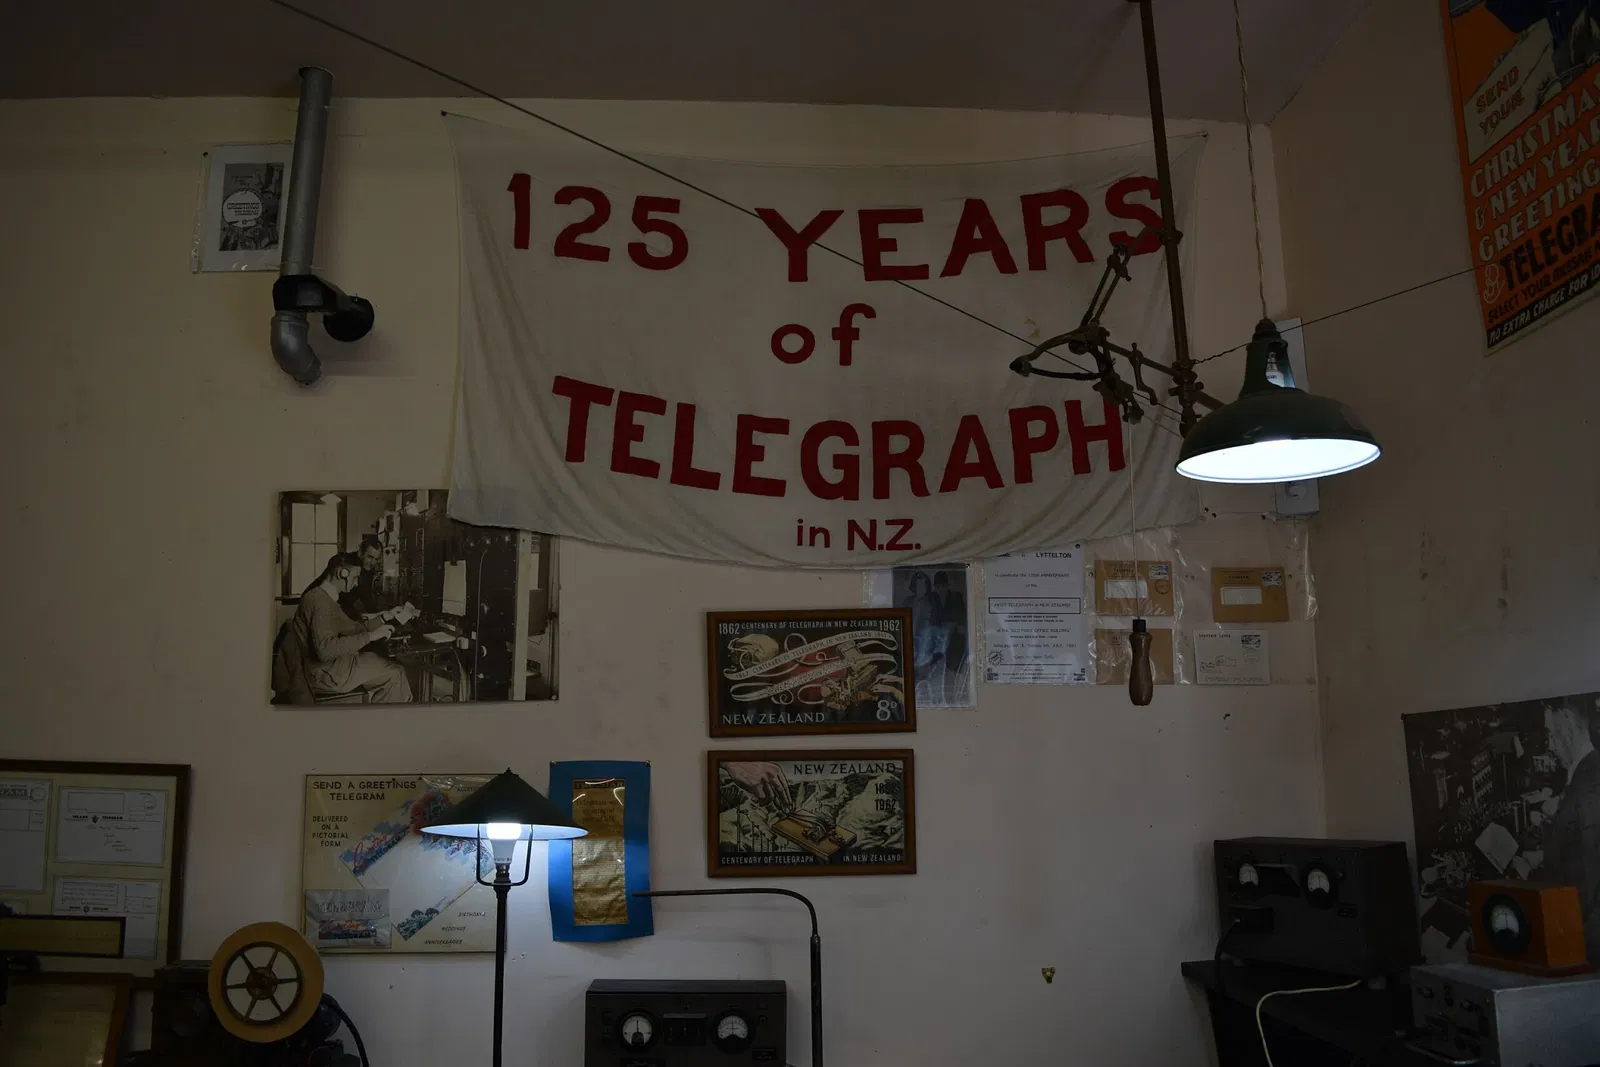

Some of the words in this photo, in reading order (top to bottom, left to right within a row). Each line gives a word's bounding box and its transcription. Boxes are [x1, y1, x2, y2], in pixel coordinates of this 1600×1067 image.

[1476, 66, 1519, 114] SEND
[1479, 91, 1525, 136] YOUR
[1489, 164, 1537, 220] NEW
[507, 173, 689, 271] 125
[754, 176, 1164, 282] YEARS
[1487, 293, 1520, 323] SELECT
[1521, 273, 1551, 300] YOUR
[1488, 327, 1500, 344] NO
[1502, 309, 1531, 336] EXTRA
[1533, 287, 1567, 317] CHARGE
[1567, 273, 1589, 296] FOR
[771, 303, 876, 366] of
[552, 375, 1126, 501] TELEGRAPH
[797, 519, 830, 548] in
[847, 519, 921, 550] N.Z.
[719, 623, 740, 635] 1862
[741, 621, 777, 631] CENTENARY
[779, 621, 787, 629] OF
[789, 620, 824, 630] TELEGRAPH
[826, 620, 832, 628] IN
[834, 620, 849, 628] NEW
[850, 619, 878, 628] ZEALAND
[879, 619, 900, 631] 1962
[752, 658, 782, 676] CENTENARY
[793, 640, 826, 660] TELEGRAPH
[848, 631, 872, 641] ZEALAND
[722, 713, 754, 725] NEW
[759, 711, 825, 725] ZEALAND
[312, 781, 342, 790] SEND
[348, 780, 355, 789] A
[359, 780, 417, 789] GREETINGS
[794, 763, 825, 775] NEW
[830, 762, 896, 775] ZEALAND
[329, 792, 385, 801] TELEGRAM
[875, 798, 896, 811] 1962
[312, 815, 348, 823] DELIVERED
[721, 856, 761, 865] CENTENARY
[764, 856, 772, 864] OF
[774, 855, 814, 864] TELEGRAPH
[843, 855, 850, 863] IN
[852, 854, 868, 863] NEW
[870, 854, 901, 863] ZEALAND
